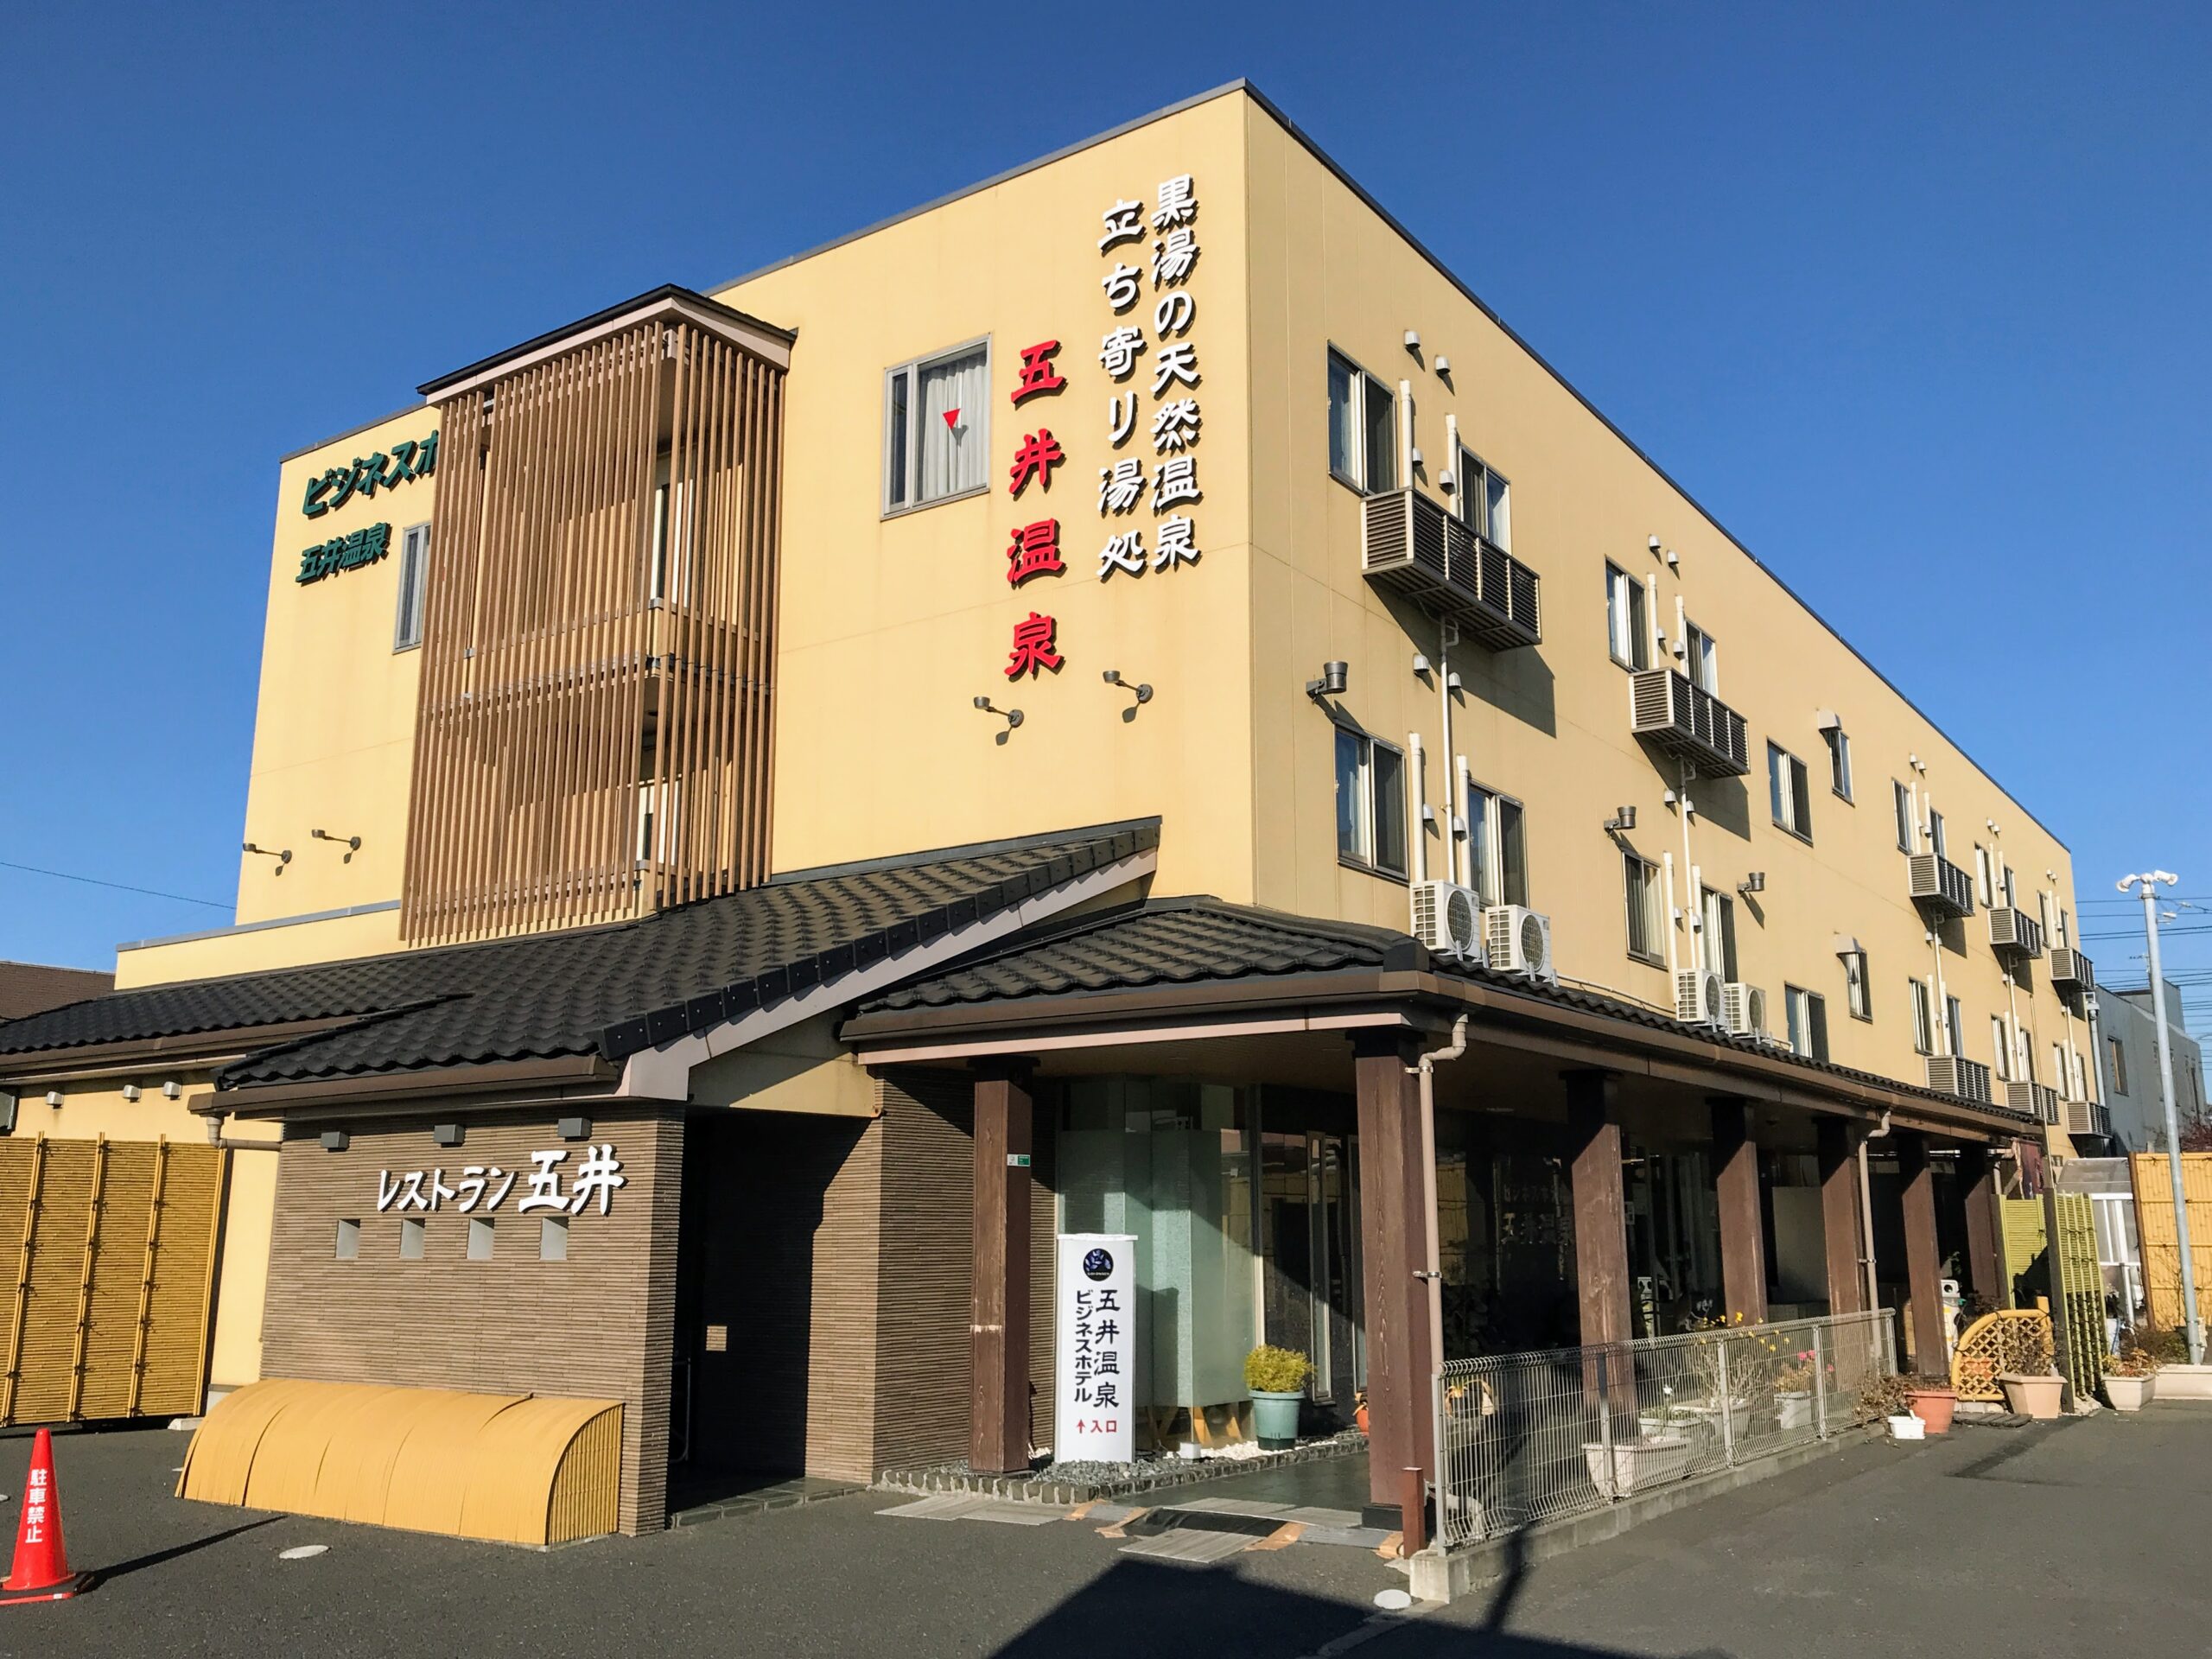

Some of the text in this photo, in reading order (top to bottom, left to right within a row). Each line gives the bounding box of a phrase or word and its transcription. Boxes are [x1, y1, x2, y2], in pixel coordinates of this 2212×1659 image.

[1097, 199, 1147, 580] 立ち寄り湯処
[1150, 174, 1200, 570] 黒湯の天然温泉
[296, 522, 391, 582] 五井温泉
[1004, 340, 1065, 679] 五井温泉
[377, 1144, 625, 1216] レストラン五井
[1074, 1289, 1094, 1403] ビジネスホテル
[1093, 1289, 1121, 1408] 五井温泉
[1090, 1420, 1117, 1433] 入口
[25, 1469, 48, 1543] 駐車禁止
